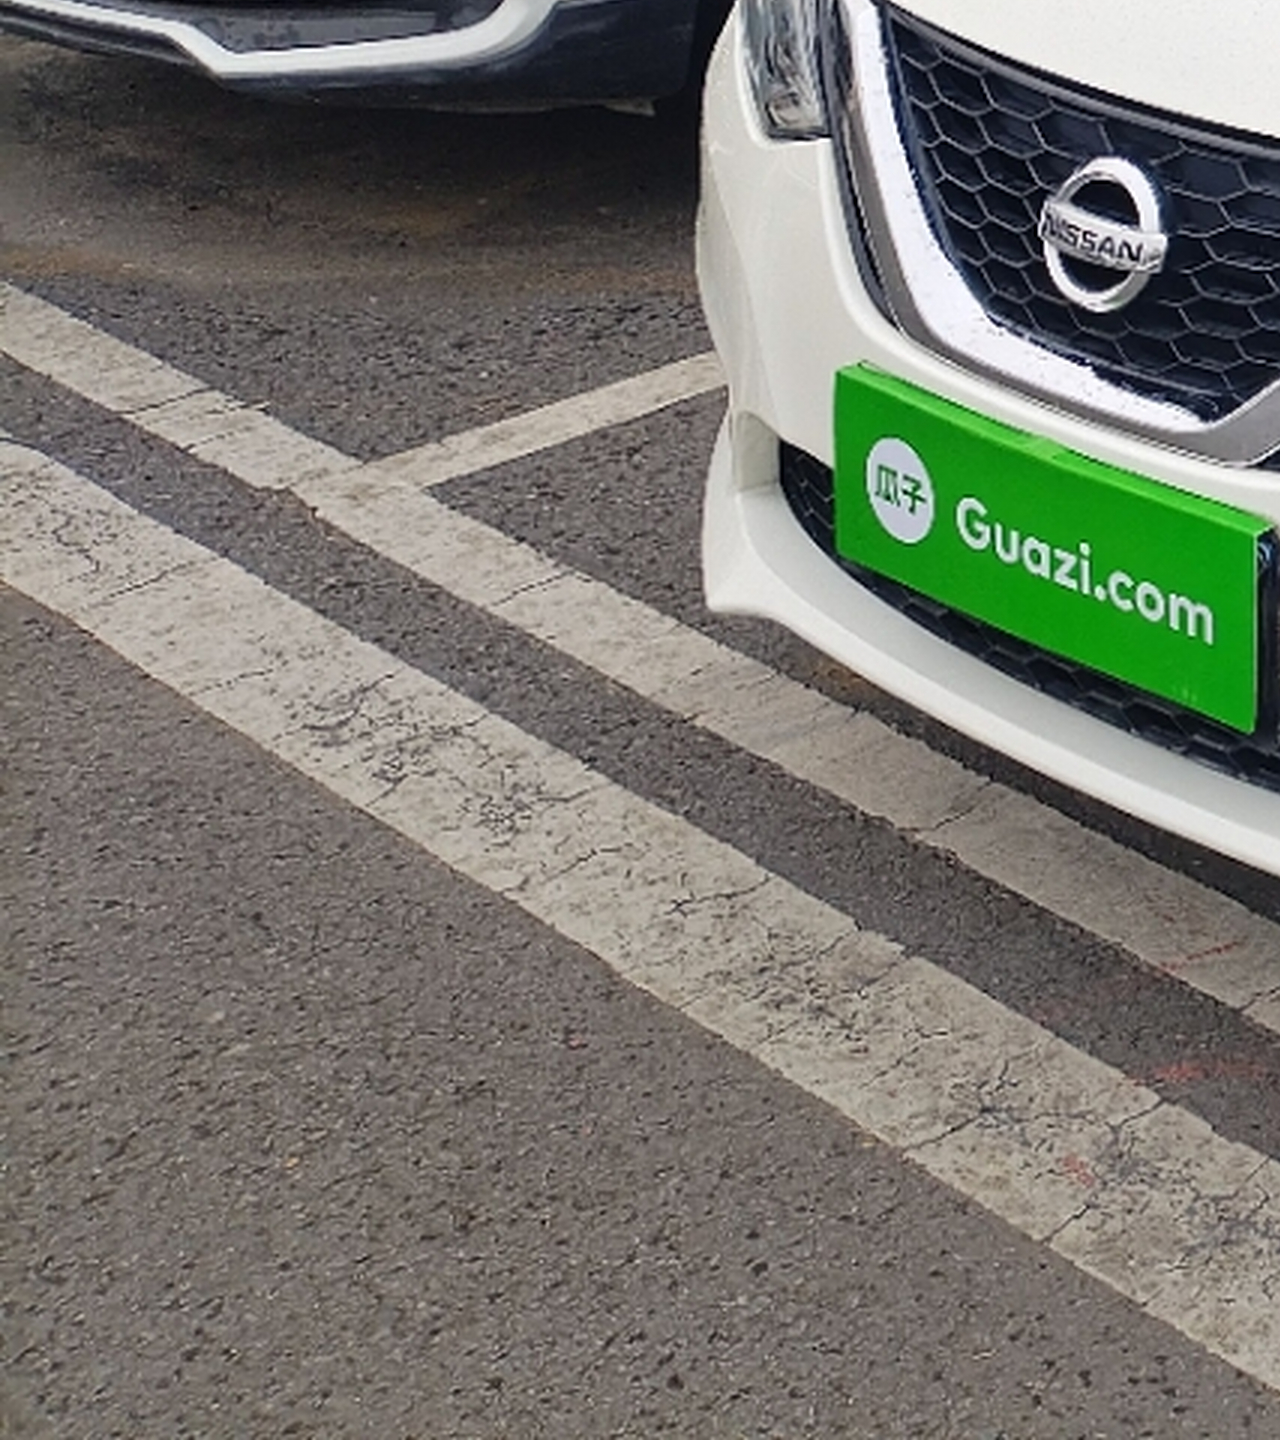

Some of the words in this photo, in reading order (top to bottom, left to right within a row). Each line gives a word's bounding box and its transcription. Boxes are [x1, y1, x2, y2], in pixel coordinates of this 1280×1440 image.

[1044, 213, 1144, 262] NISSAN
[874, 463, 927, 516] 瓜子
[956, 497, 1214, 646] Guazi.com
